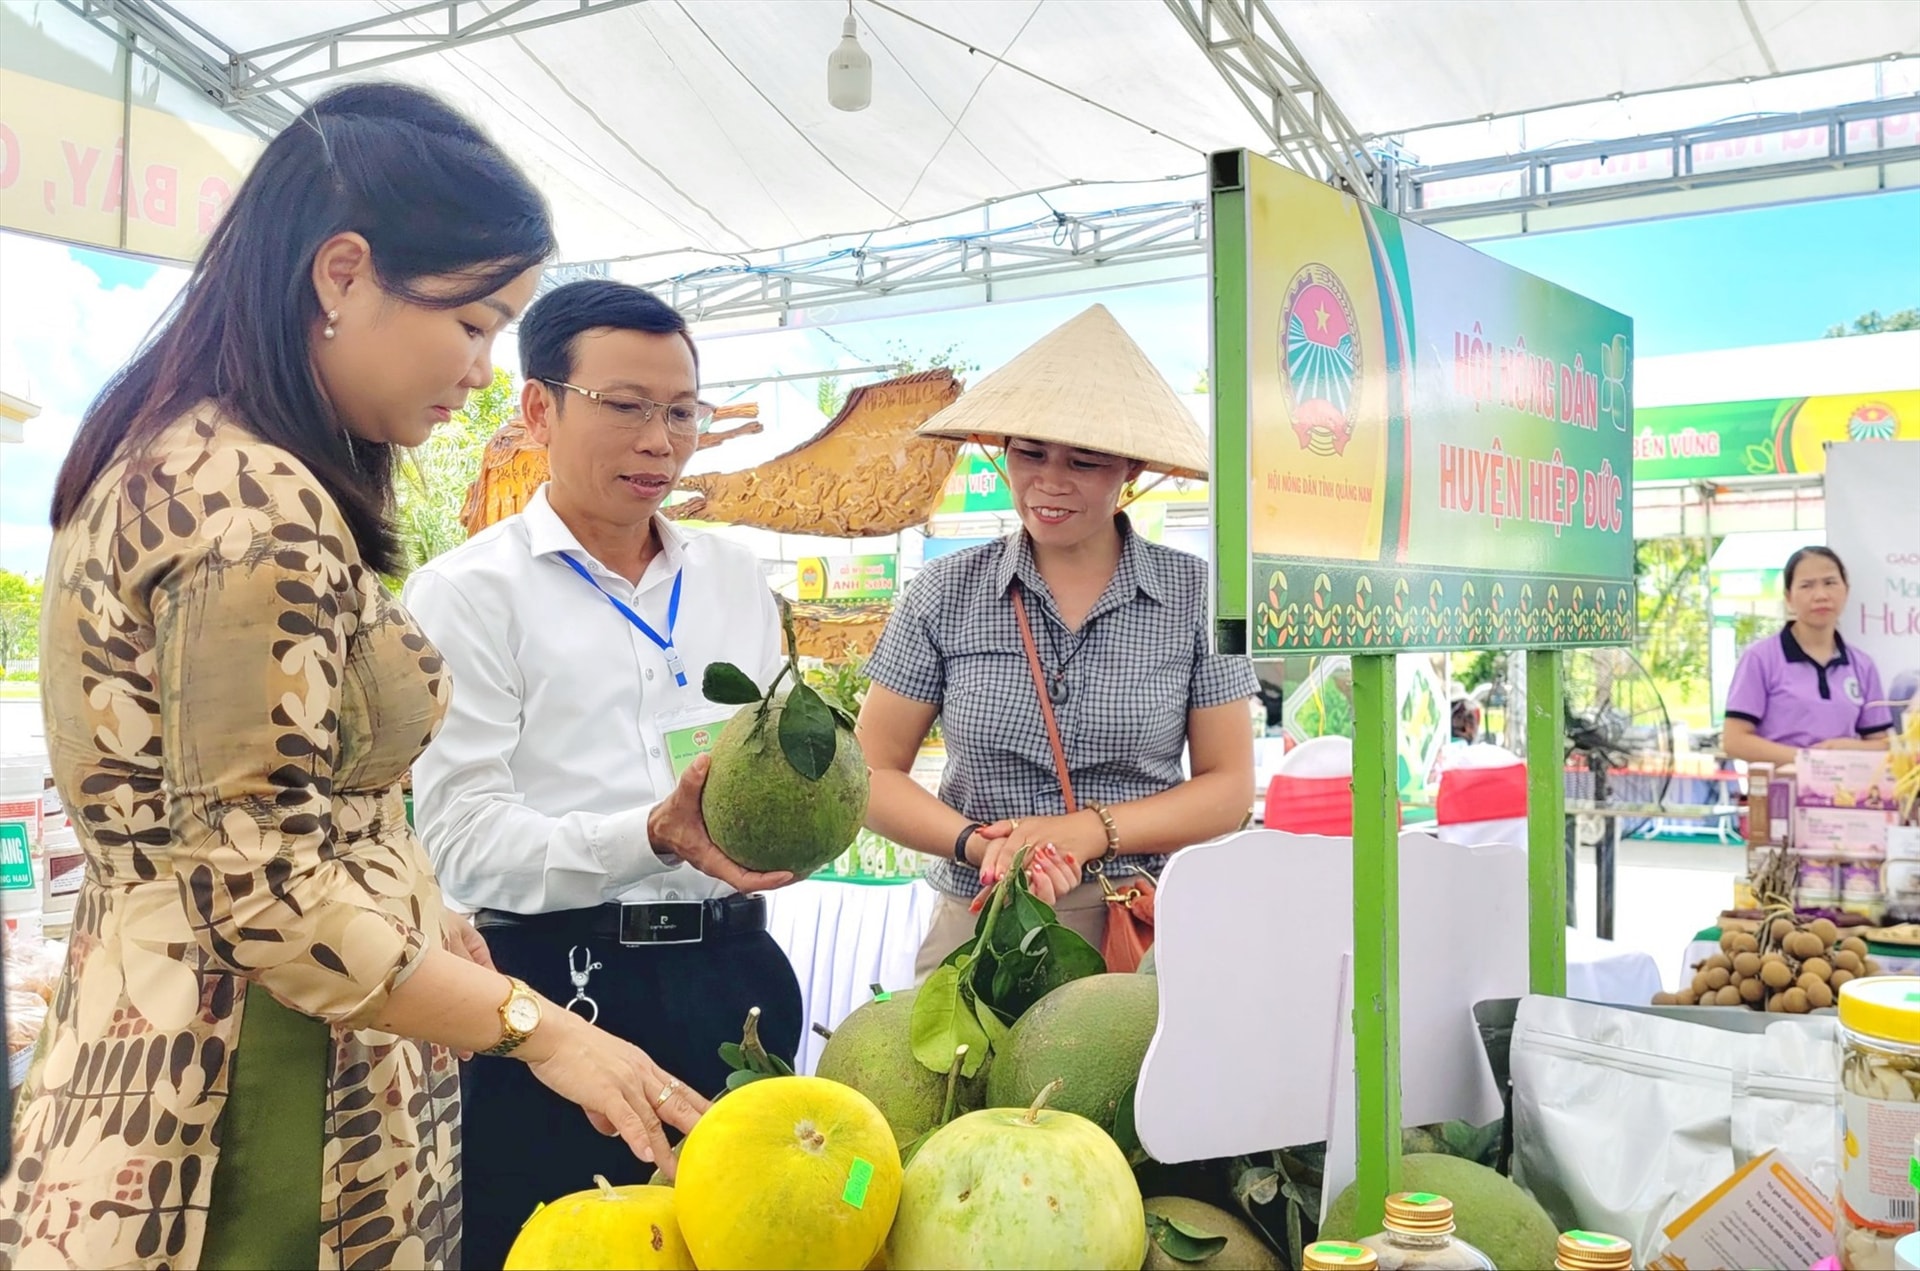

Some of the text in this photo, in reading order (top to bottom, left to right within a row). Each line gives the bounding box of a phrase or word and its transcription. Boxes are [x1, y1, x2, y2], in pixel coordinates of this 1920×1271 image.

[1454, 321, 1598, 431] HỘI NÔNG DÂN
[968, 469, 997, 497] VIỆT
[1267, 469, 1372, 503] HỘI NÔNG DÂN TỈNH QUẢNG NAM
[1439, 437, 1622, 538] HUYỆN HIỆP ĐỨC
[833, 580, 860, 590] ANH
